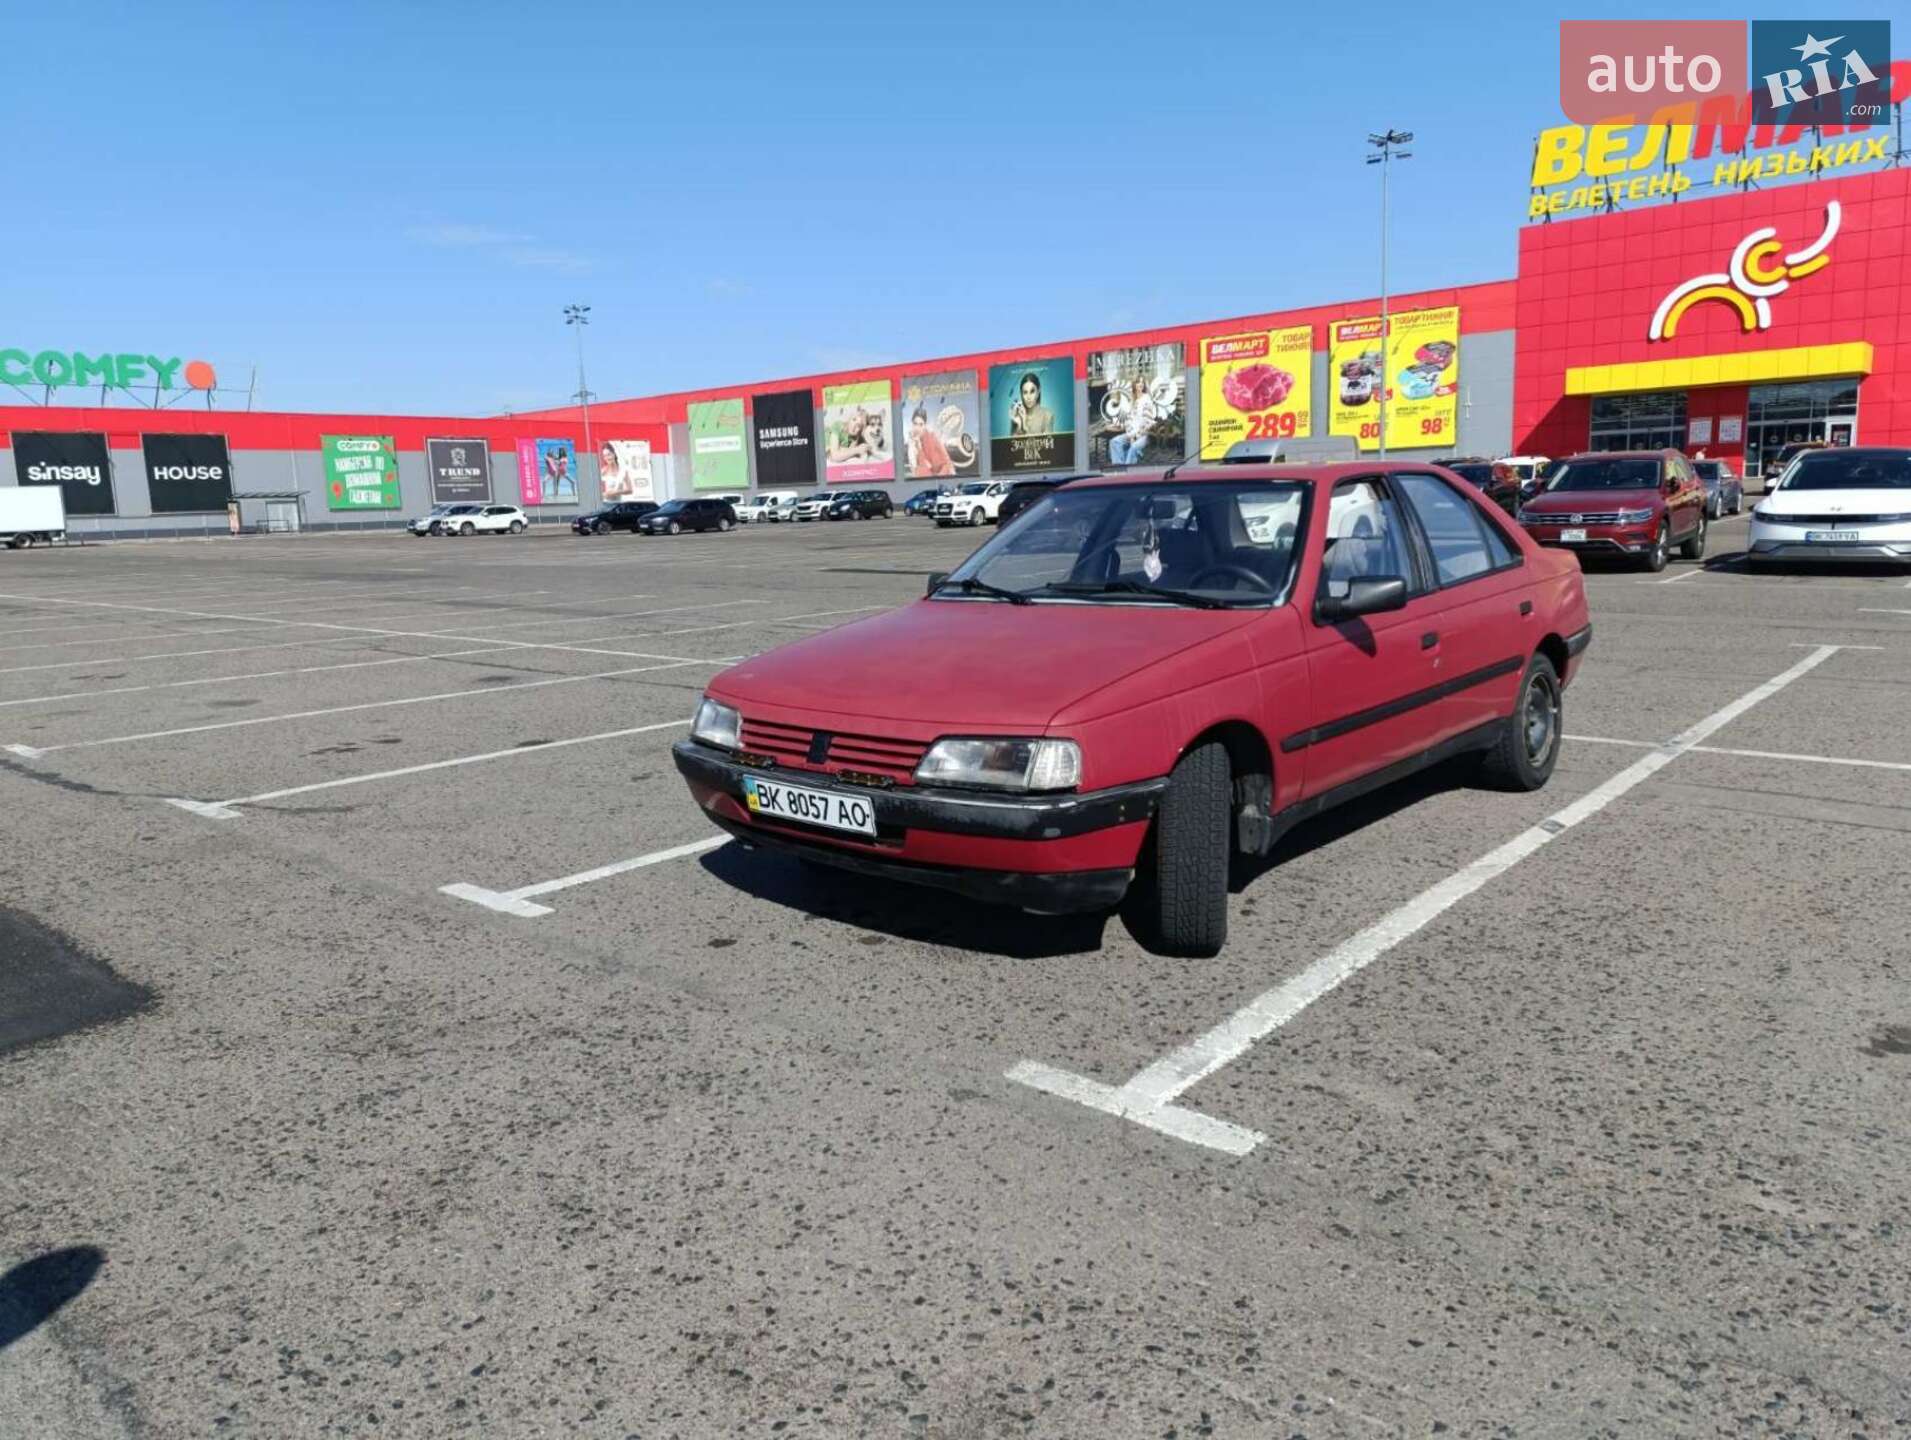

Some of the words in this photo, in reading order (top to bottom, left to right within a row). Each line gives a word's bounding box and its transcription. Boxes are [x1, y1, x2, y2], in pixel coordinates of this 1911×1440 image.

[1529, 171, 1692, 217] ВЕЛЕТЕНЬ
[1713, 134, 1890, 187] НИЗЬКИХ
[0, 348, 181, 390] COMFY
[759, 425, 799, 440] SAMSUNG
[1245, 411, 1297, 441] 289
[1420, 417, 1442, 435] 98
[28, 460, 101, 486] sinsay
[756, 783, 784, 812] BK
[787, 790, 829, 821] 8057
[838, 800, 866, 828] AO
